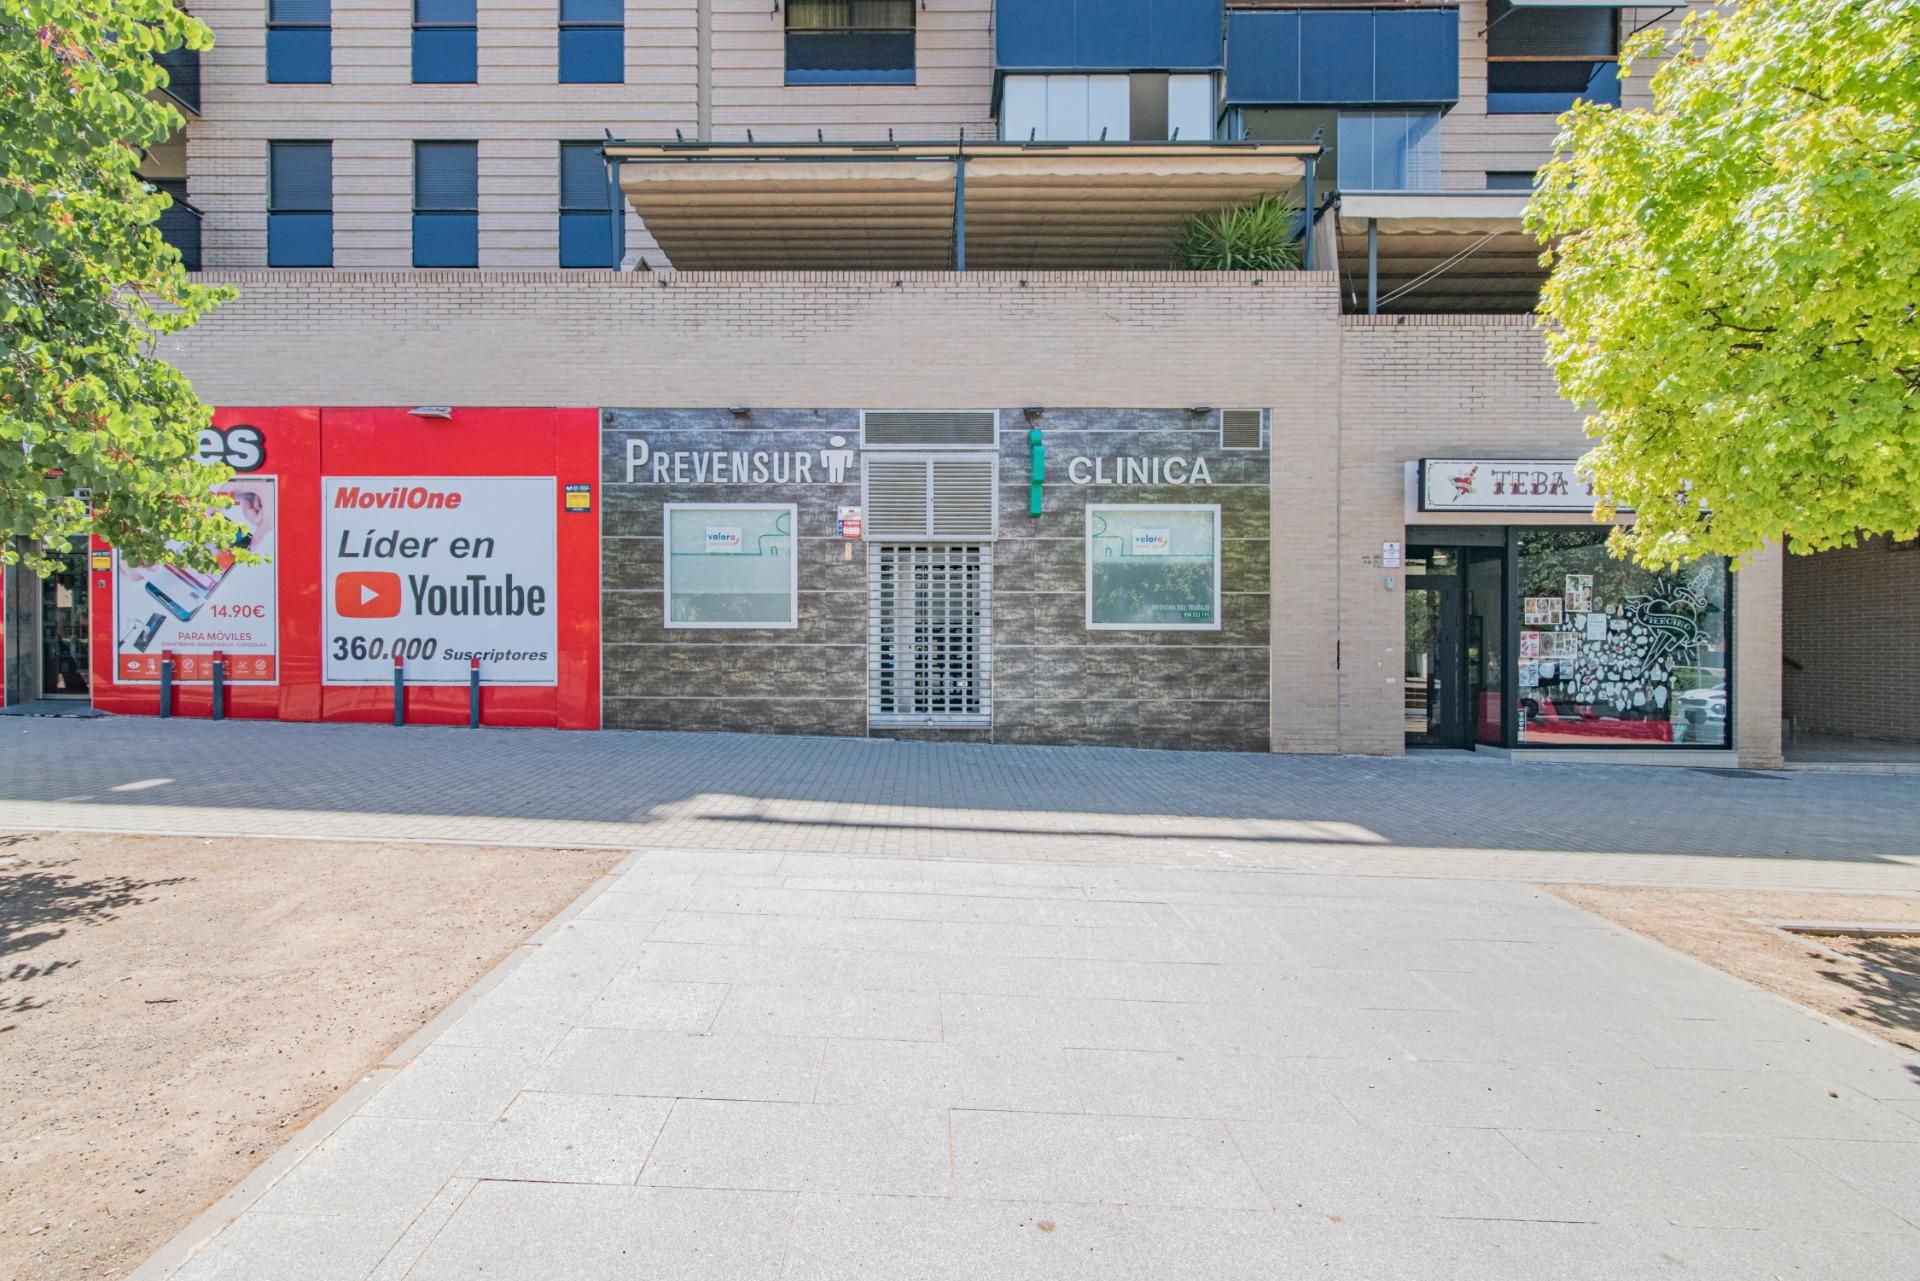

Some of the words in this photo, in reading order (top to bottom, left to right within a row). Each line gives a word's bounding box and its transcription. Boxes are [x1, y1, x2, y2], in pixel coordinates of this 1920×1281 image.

[192, 428, 260, 468] es
[626, 438, 813, 484] PREVENSUR
[1068, 456, 1213, 485] CLINICA
[1491, 469, 1568, 496] TEBA
[334, 486, 462, 509] MovilOne
[338, 529, 438, 558] Líder
[450, 536, 495, 558] en
[707, 532, 737, 541] valora
[408, 573, 546, 616] YouTube
[211, 604, 266, 618] 14.90€
[178, 632, 205, 640] PARA
[207, 630, 252, 641] MÓVILES
[332, 636, 437, 661] 360.000
[442, 648, 548, 663] Suscriptores
